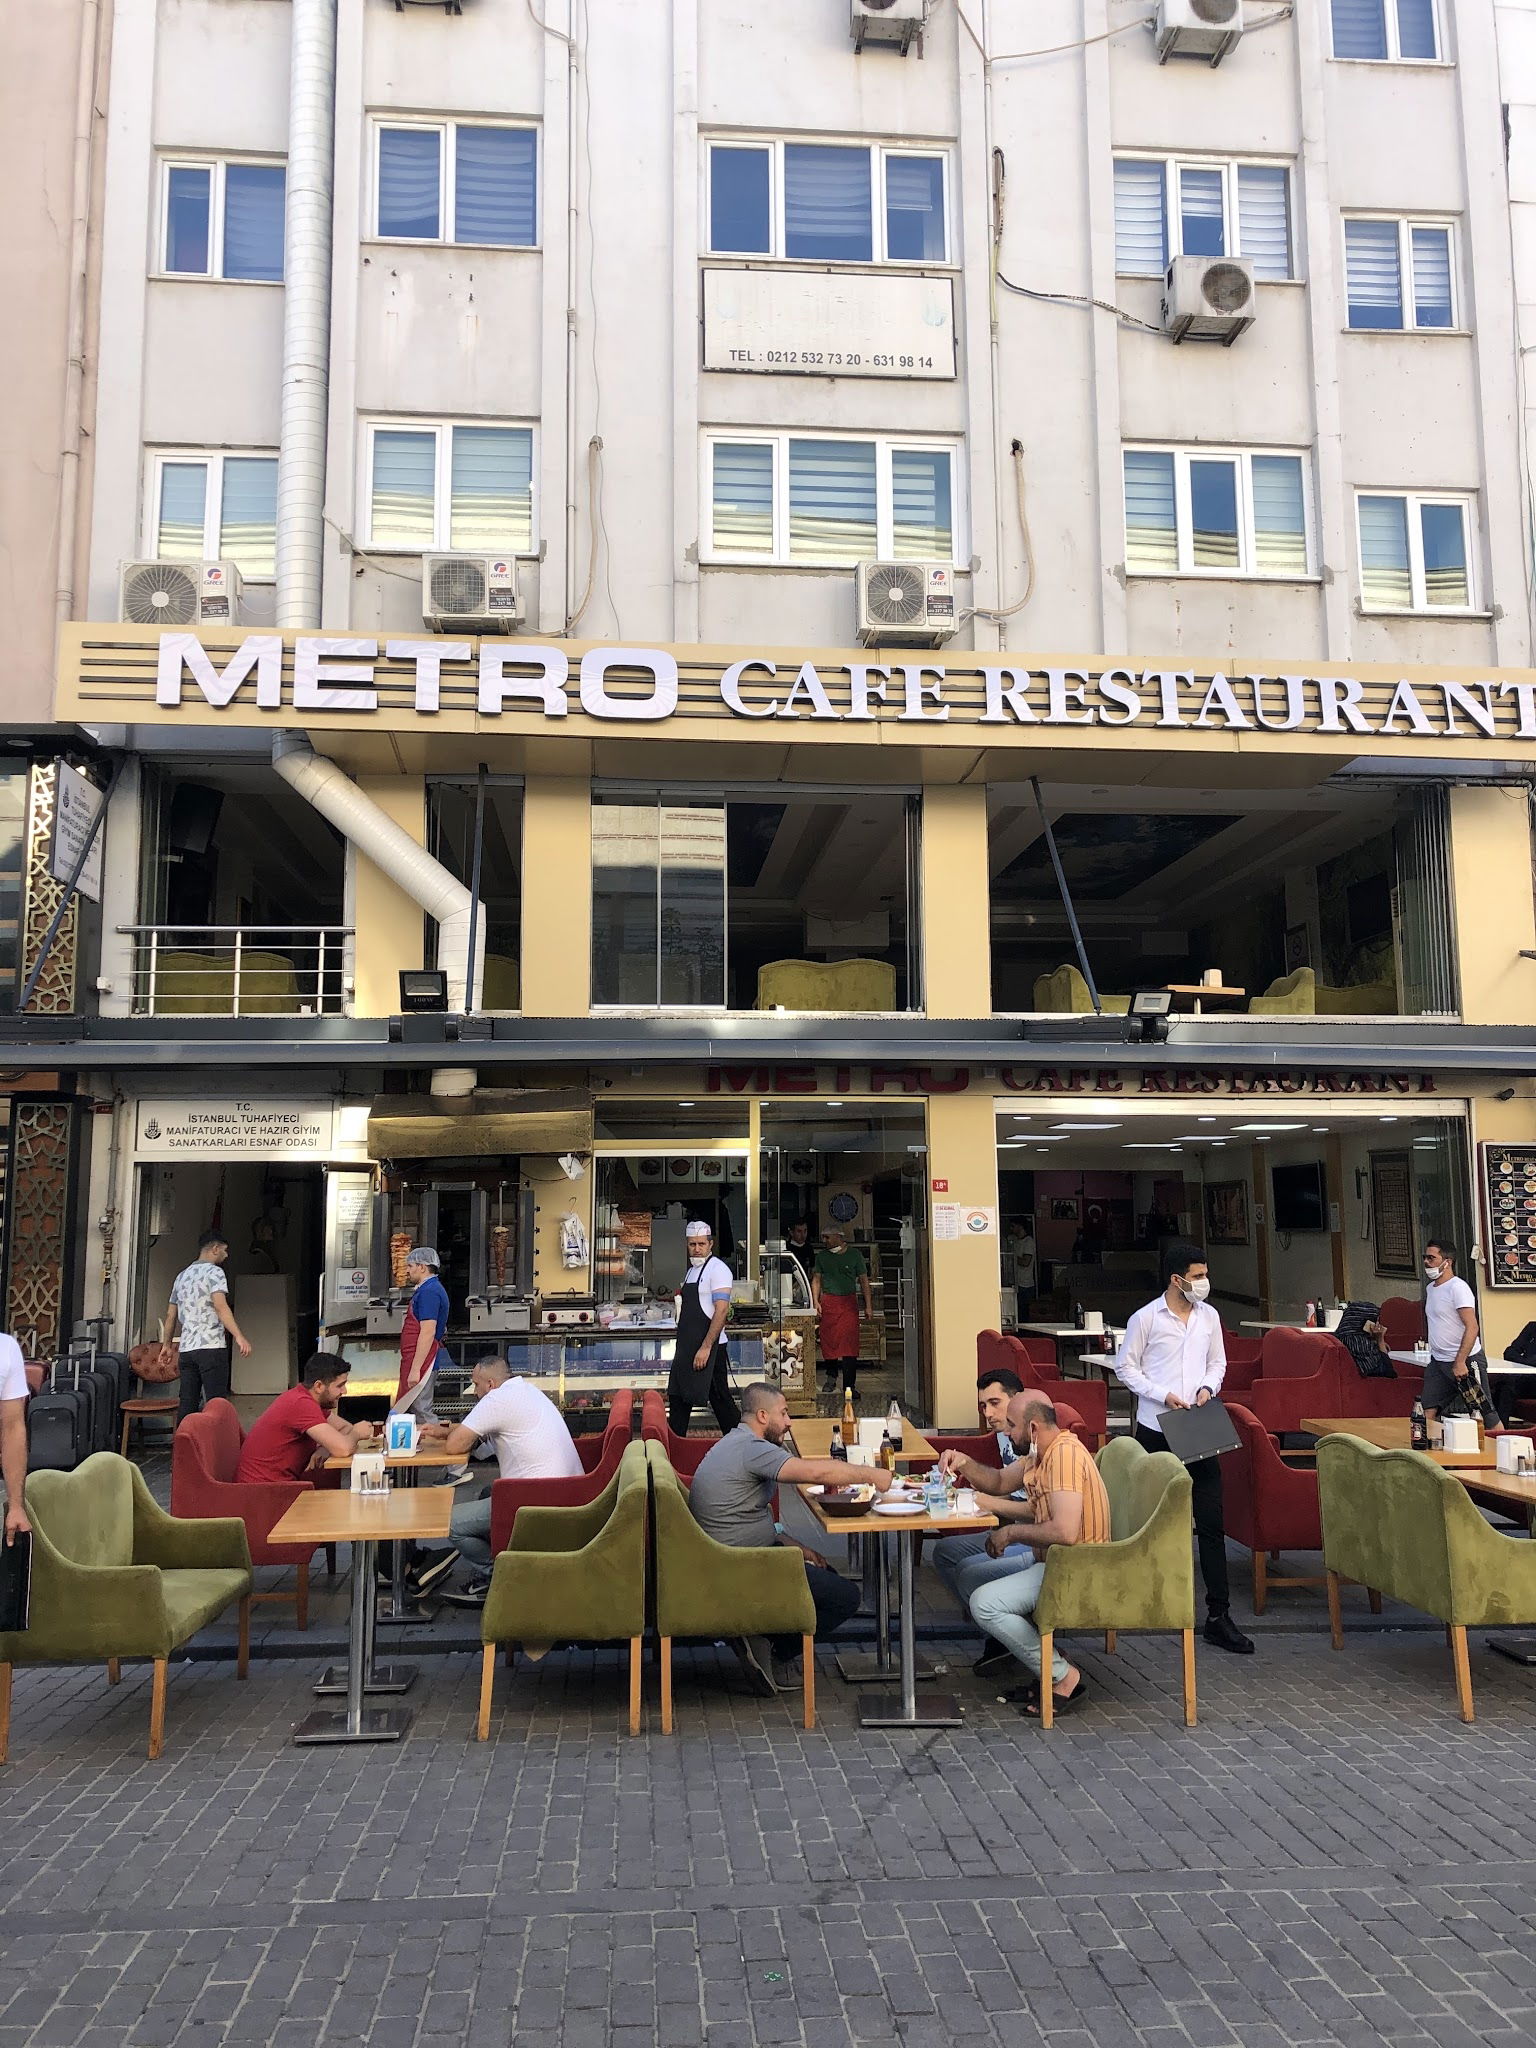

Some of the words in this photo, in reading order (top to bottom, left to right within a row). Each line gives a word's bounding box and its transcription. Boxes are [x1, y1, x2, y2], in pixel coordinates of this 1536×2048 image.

[728, 349, 755, 362] TEL
[767, 350, 797, 363] 0212
[801, 352, 824, 364] 532
[827, 353, 843, 365] 73
[846, 353, 861, 366] 20
[873, 354, 895, 367] 631
[899, 355, 914, 368] 98
[918, 356, 933, 369] 14
[156, 632, 680, 719] METRO
[719, 658, 951, 722] CAFE
[977, 665, 1536, 738] RESTAURANT
[235, 1102, 253, 1111] T.C.
[188, 1113, 238, 1123] İSTANBUL
[240, 1113, 300, 1123] TUHAFİYECİ
[166, 1125, 241, 1135] MANİFATURACI
[243, 1126, 257, 1135] VE
[260, 1126, 290, 1135] HAZIR
[292, 1125, 320, 1135] GİYİM
[169, 1138, 247, 1147] SANATKARLARI
[249, 1138, 284, 1147] ESNAF
[285, 1138, 317, 1147] ODASI
